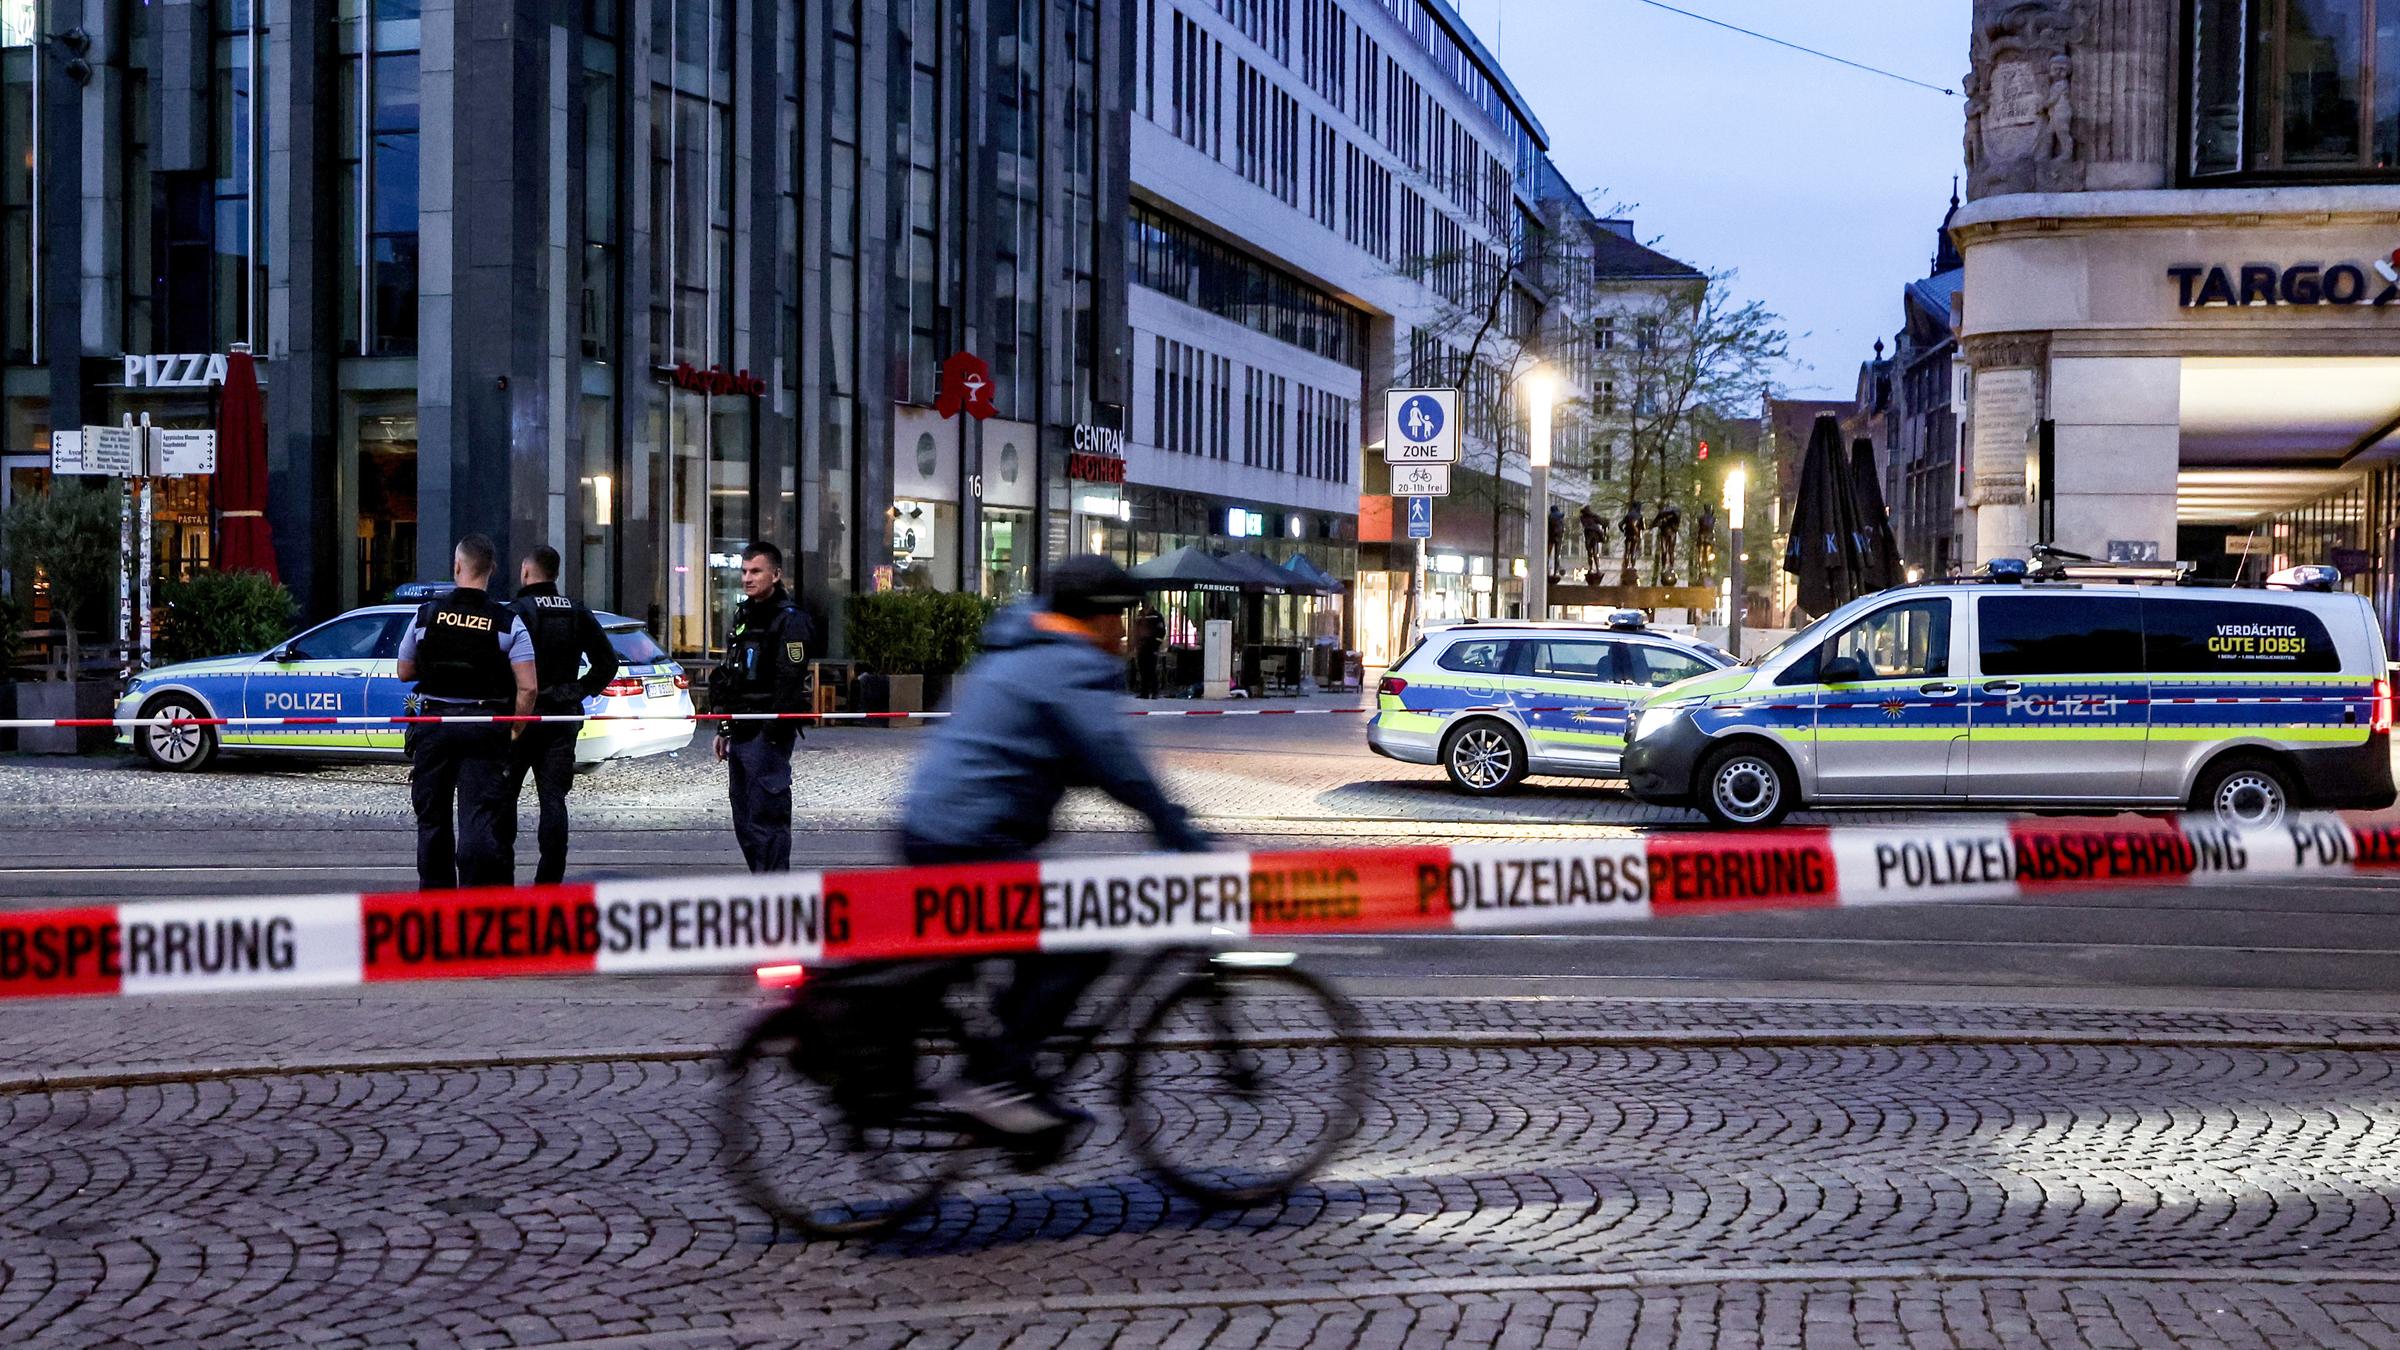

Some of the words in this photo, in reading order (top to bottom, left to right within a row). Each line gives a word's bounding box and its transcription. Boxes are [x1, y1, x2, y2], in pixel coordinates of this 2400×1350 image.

[2167, 264, 2365, 308] TARGO
[125, 354, 228, 387] PIZZA
[1403, 446, 1438, 457] ZONE
[968, 475, 981, 497] 16
[1398, 484, 1425, 492] 20-11h
[1427, 484, 1443, 492] frei
[1194, 584, 1240, 592] STARBUCKS
[535, 596, 572, 608] POLIZEI
[437, 611, 493, 631] POLIZEI
[2217, 623, 2296, 636] VERDÄCHTIG
[2208, 637, 2254, 652] GUTE
[2259, 638, 2305, 653] JOBS!
[265, 692, 342, 710] POLIZEI
[2006, 694, 2117, 716] POLIZEI
[366, 891, 852, 964] POLIZEIABSPERRUNG
[914, 867, 1361, 936] POLIZEIABSPERRUNG
[1416, 846, 1826, 914] POLIZEIABSPERRUNG
[1875, 824, 2247, 888] POLIZEIABSPERRUNG
